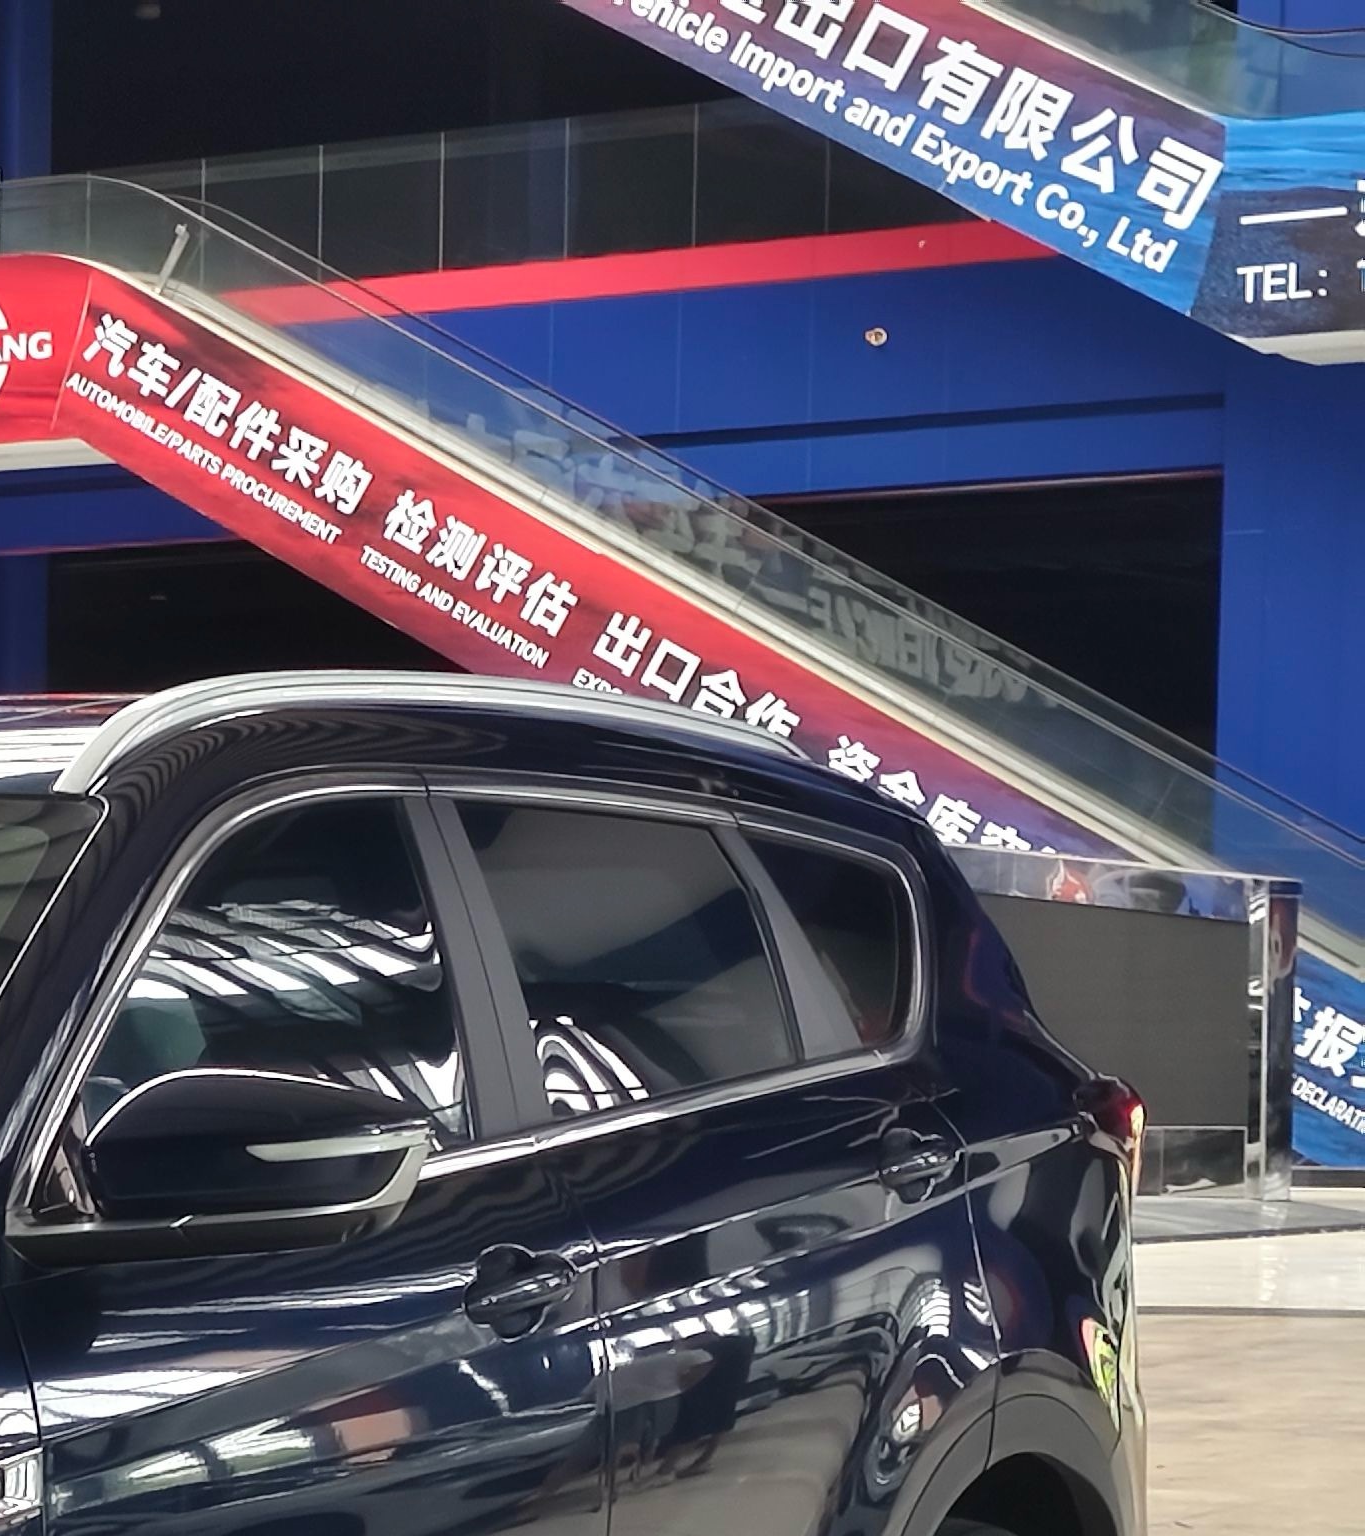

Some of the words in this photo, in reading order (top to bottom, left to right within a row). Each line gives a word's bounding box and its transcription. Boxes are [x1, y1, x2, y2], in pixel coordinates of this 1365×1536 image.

[612, 0, 730, 54] ehicle
[728, 31, 846, 114] Import
[844, 96, 912, 148] and
[910, 121, 1035, 206] Export
[1034, 182, 1100, 247] Co.,
[1106, 217, 1179, 274] Ltd
[65, 372, 224, 475] AUTOMOBILE/PARTS
[220, 463, 343, 545] PROCUREMENT
[360, 544, 423, 594] TESTING
[417, 581, 455, 612] AND
[451, 600, 550, 670] EVALUATION
[82, 313, 373, 516] 汽车/配件采购
[383, 489, 579, 637] 检测评估
